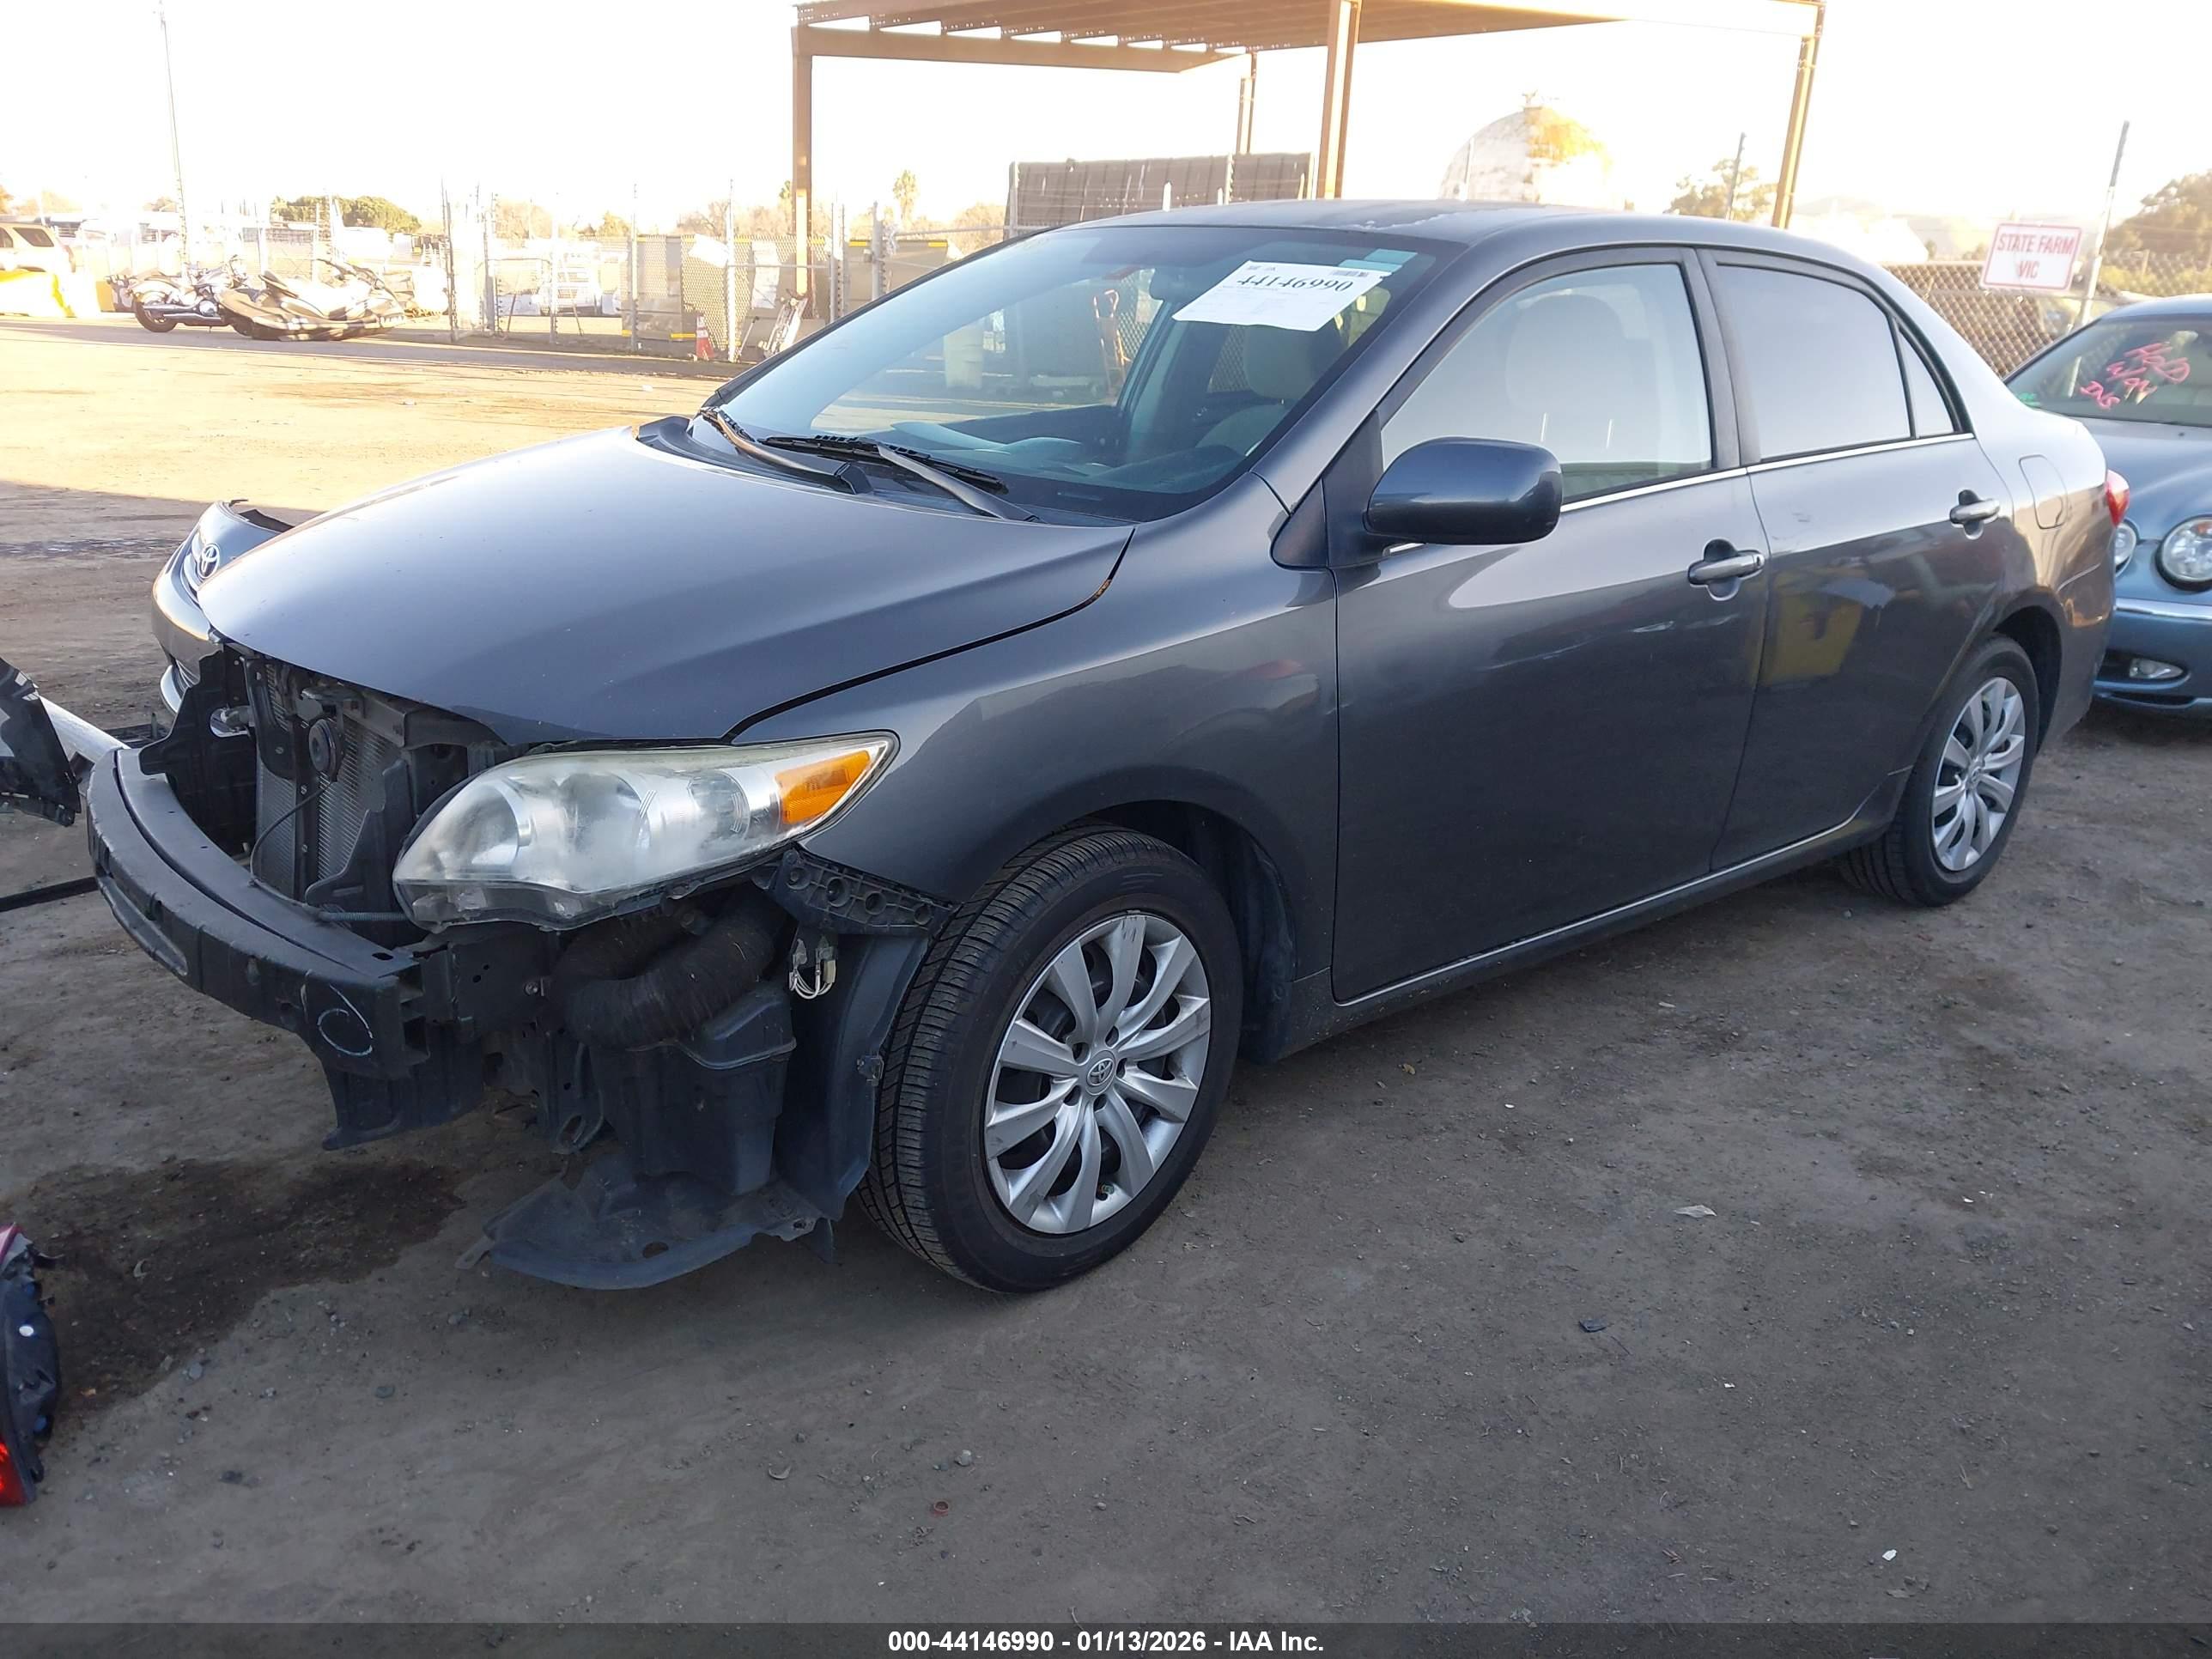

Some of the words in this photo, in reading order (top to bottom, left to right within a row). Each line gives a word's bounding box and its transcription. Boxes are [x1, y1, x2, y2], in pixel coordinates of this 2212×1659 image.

[1998, 234, 2036, 252] STATE
[2039, 235, 2074, 254] FARM
[2017, 261, 2039, 279] VIC
[1237, 275, 1353, 291] 44146990
